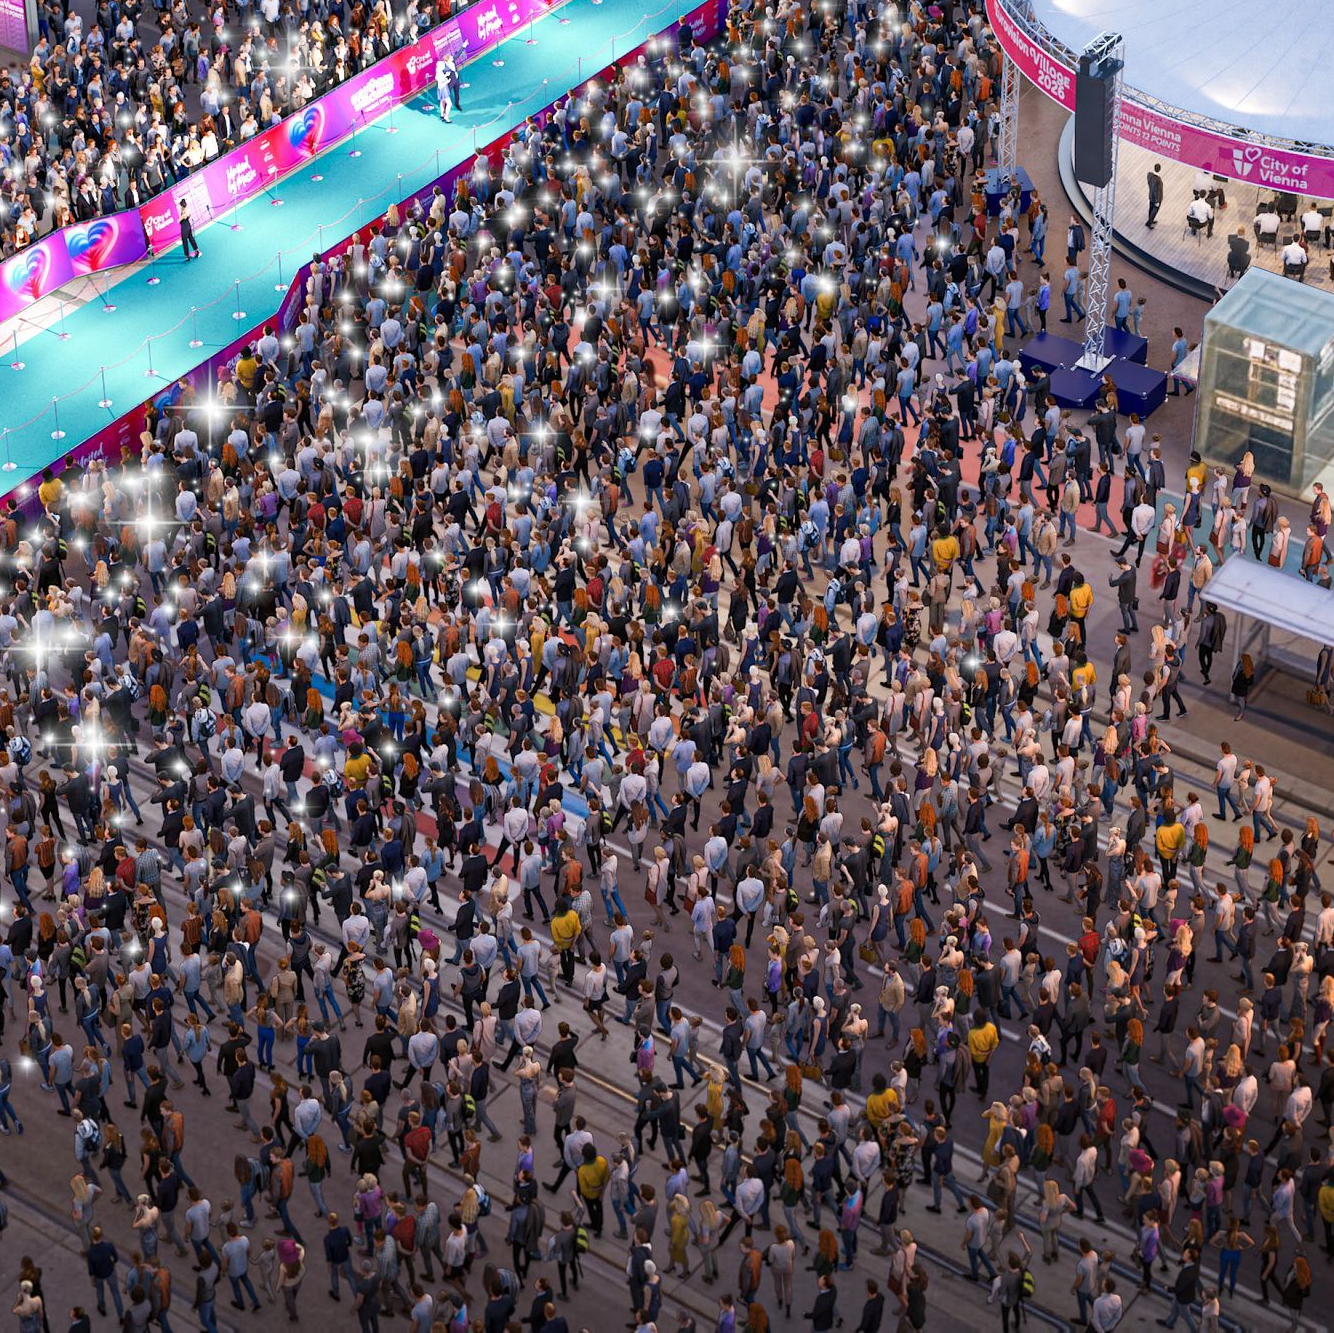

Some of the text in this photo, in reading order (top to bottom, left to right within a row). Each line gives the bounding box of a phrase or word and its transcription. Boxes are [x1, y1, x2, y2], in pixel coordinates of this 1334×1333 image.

[1029, 48, 1071, 90] Village
[1037, 69, 1065, 100] 2026
[1142, 132, 1181, 153] 12 POINTS
[1143, 118, 1182, 144] Vienna
[1261, 156, 1309, 177] City of
[1259, 168, 1308, 190] Vienna
